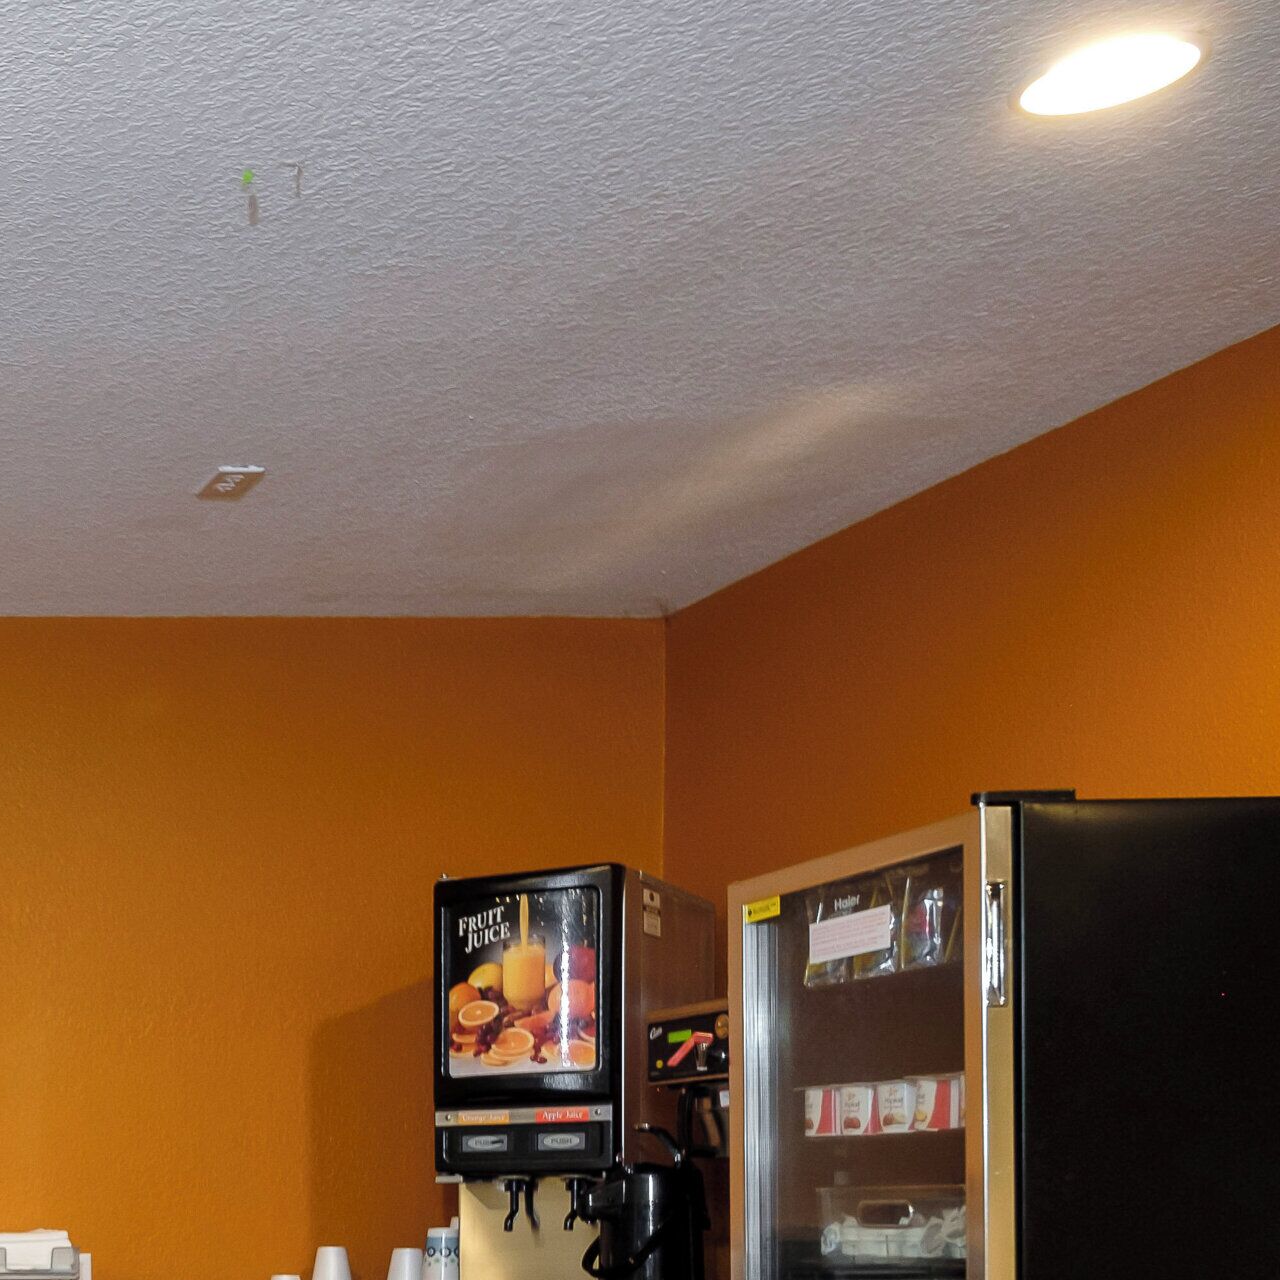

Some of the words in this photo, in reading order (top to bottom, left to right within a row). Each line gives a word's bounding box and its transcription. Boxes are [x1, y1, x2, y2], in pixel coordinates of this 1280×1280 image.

[834, 894, 860, 912] Haier
[458, 905, 505, 937] FRUIT
[465, 922, 511, 954] JUICE
[543, 1110, 563, 1121] Apple
[566, 1109, 583, 1119] Juice
[550, 1137, 573, 1145] PUSH
